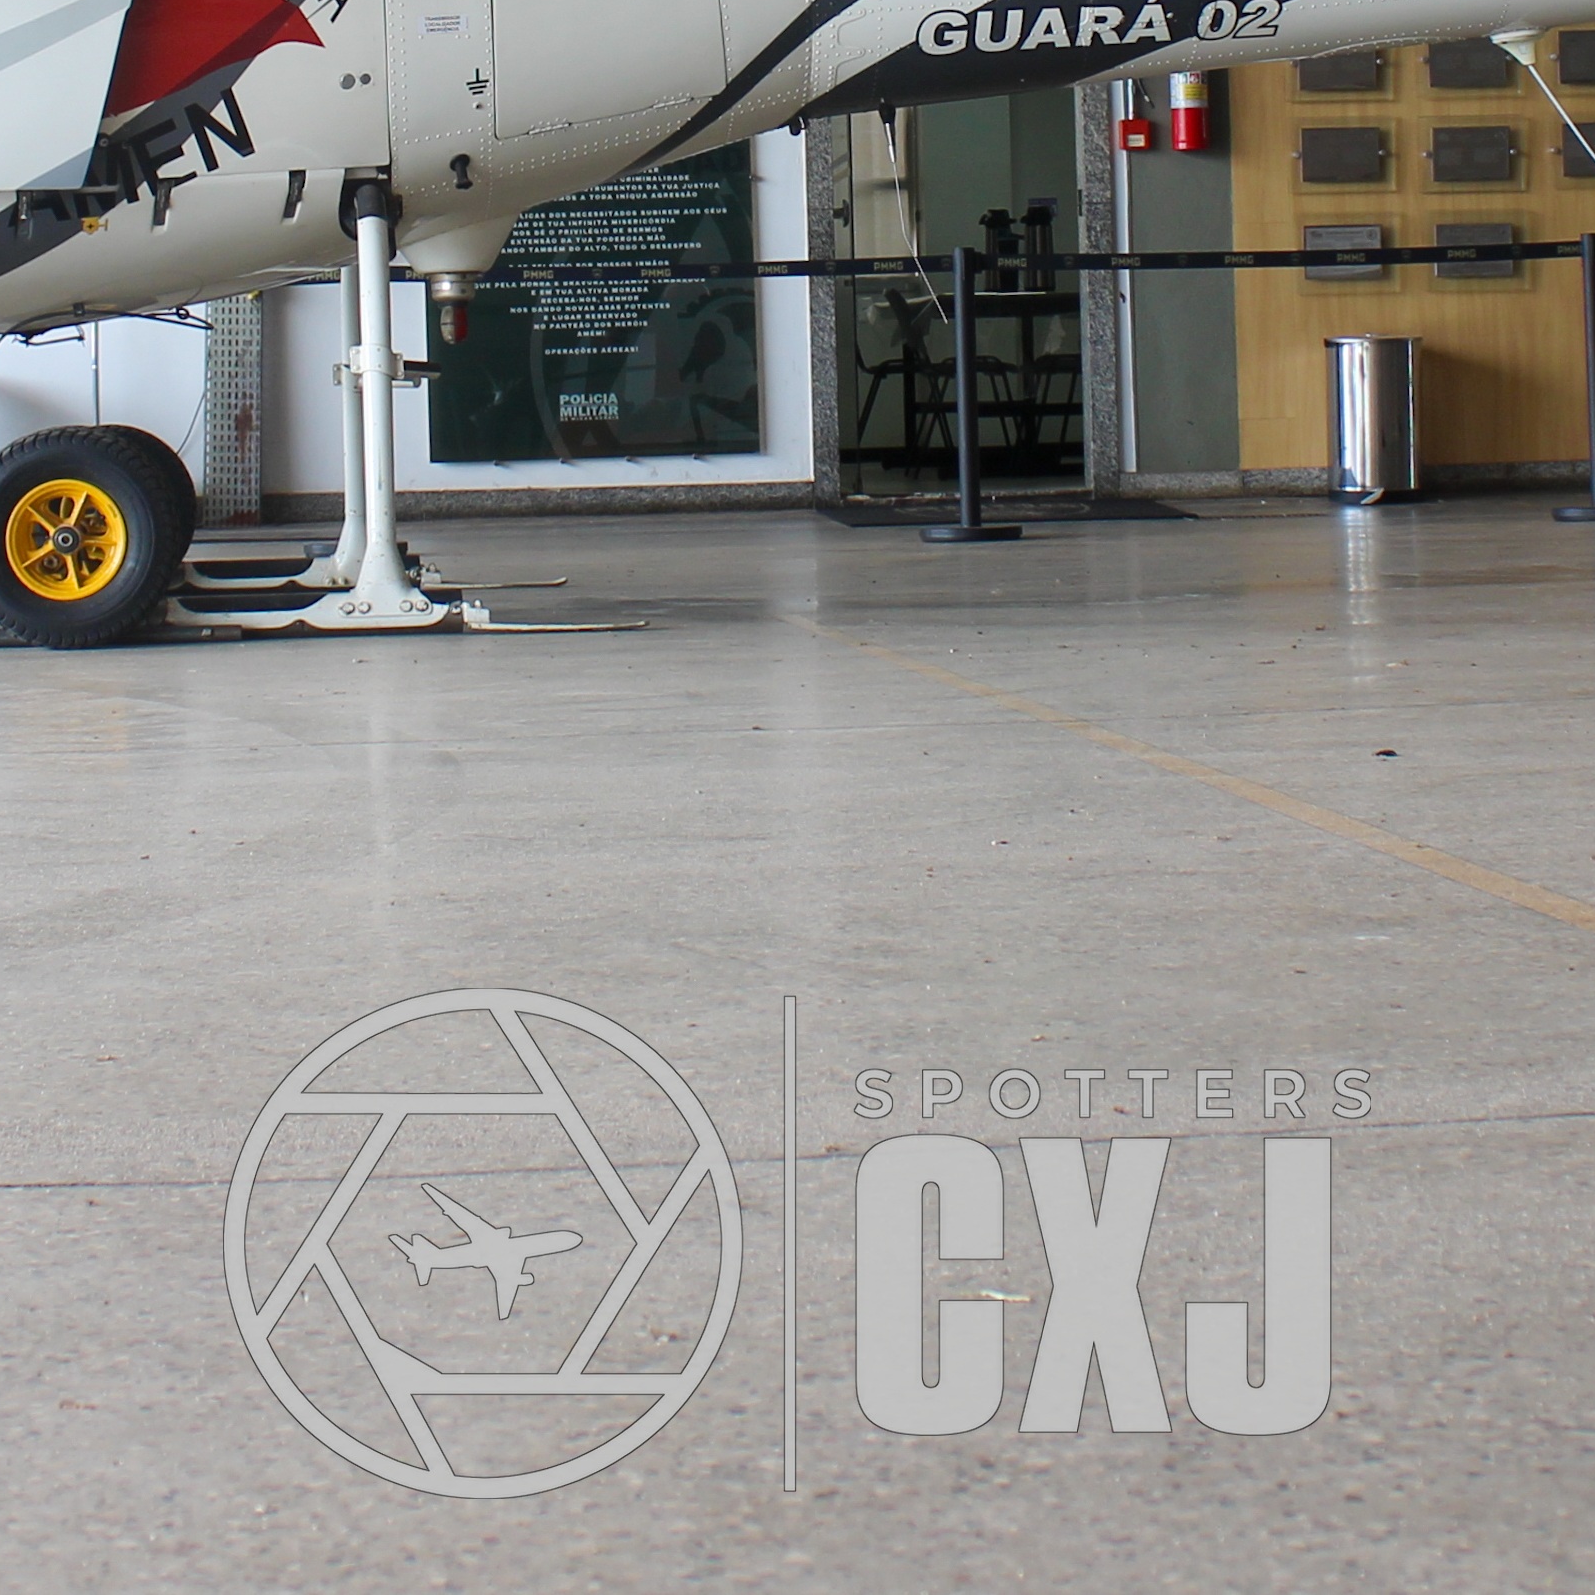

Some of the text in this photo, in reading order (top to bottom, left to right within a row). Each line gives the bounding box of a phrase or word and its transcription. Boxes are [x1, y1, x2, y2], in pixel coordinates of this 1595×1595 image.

[682, 182, 721, 190] JUSTIÇA
[651, 191, 698, 199] AGRESSÃO
[569, 209, 637, 219] NECESSITADOS
[568, 219, 609, 227] INFINITA
[611, 217, 676, 225] MISERICÓRDIA
[557, 227, 610, 235] PRIVILÉGIO
[510, 237, 558, 246] EXTENSÃO
[596, 235, 644, 243] PODEROSA
[528, 245, 566, 253] TAMBÉM
[1447, 249, 1477, 259] PMMG
[997, 257, 1027, 267] PMMG
[1111, 256, 1141, 266] PMMG
[1224, 255, 1254, 265] PMMG
[1336, 252, 1366, 263] PMMG
[757, 265, 788, 274] PMMG
[873, 261, 904, 271] PMMG
[523, 270, 554, 279] PMMG
[640, 268, 672, 278] PMMG
[624, 302, 671, 310] POTENTES
[552, 313, 582, 321] LUGAR
[585, 312, 638, 320] RESERVADO
[549, 321, 591, 329] PANTEÃO
[544, 347, 598, 355] OPERAÇÕES
[559, 405, 619, 417] MILITAR
